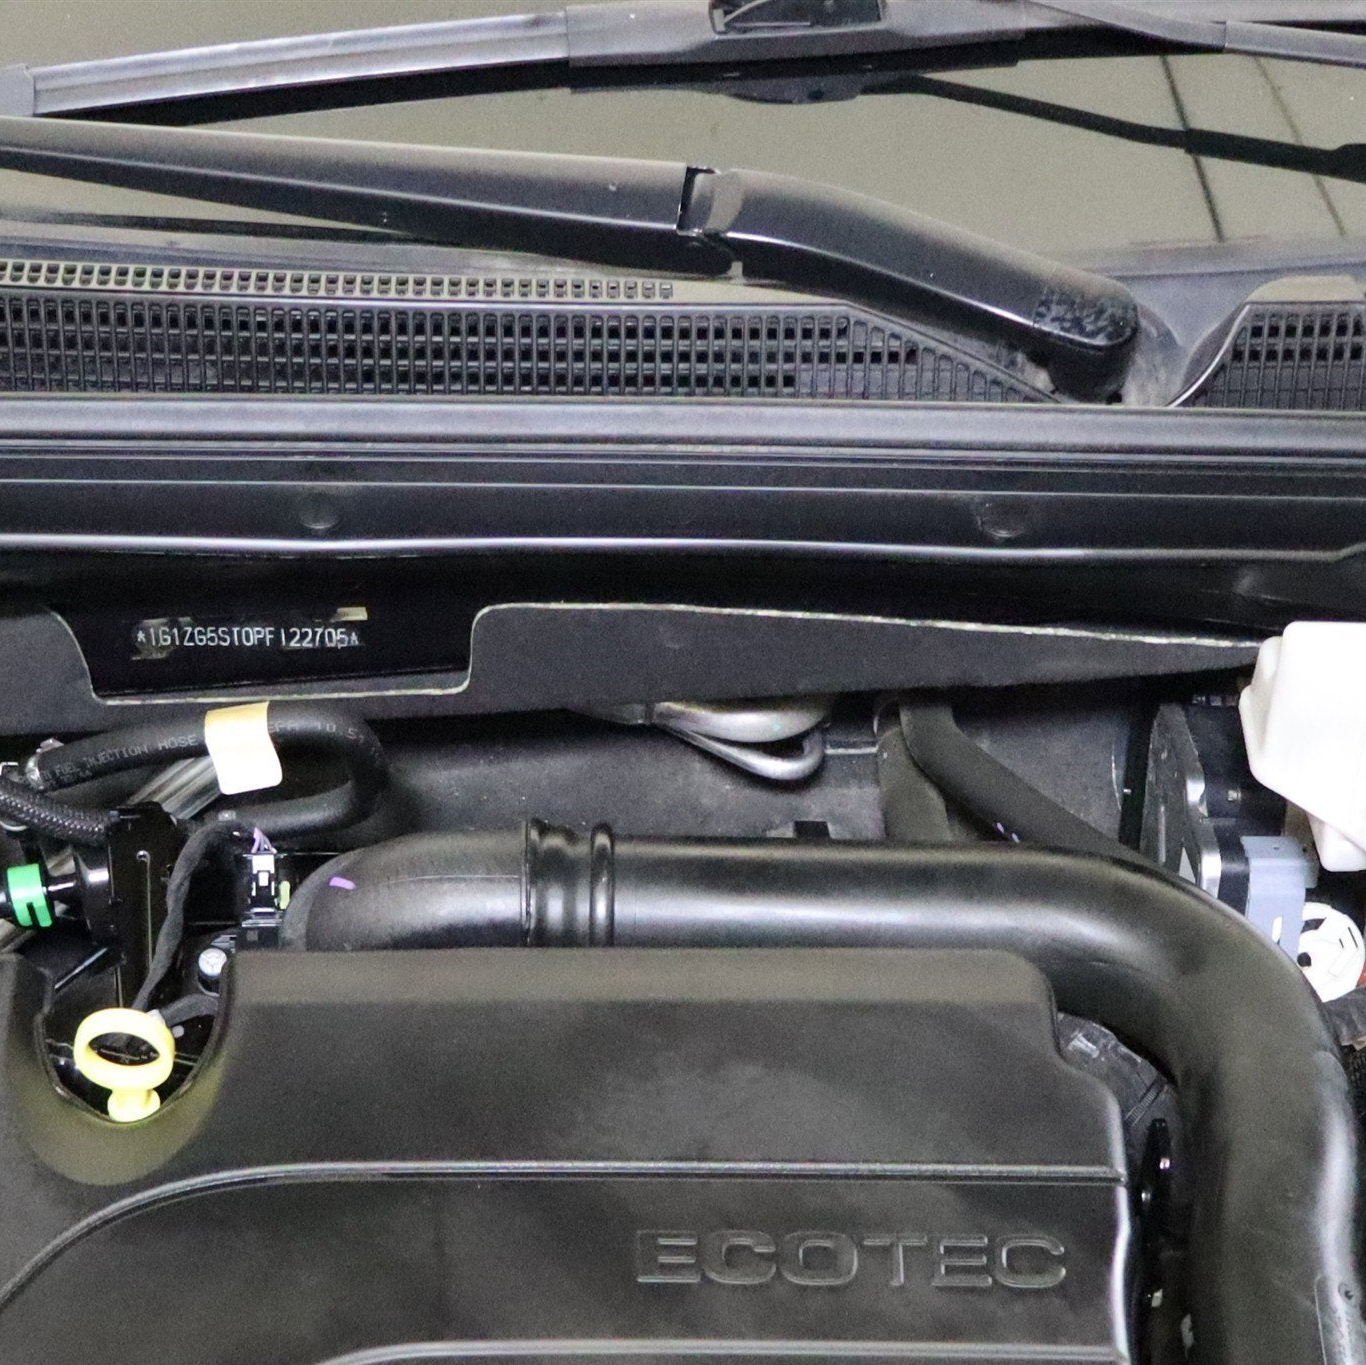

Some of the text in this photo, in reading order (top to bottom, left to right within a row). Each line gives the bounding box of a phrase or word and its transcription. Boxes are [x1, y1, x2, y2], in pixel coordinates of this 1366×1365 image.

[83, 744, 148, 768] INJECTION
[158, 734, 198, 751] HOSE
[635, 1229, 1067, 1289] ECOTEC
